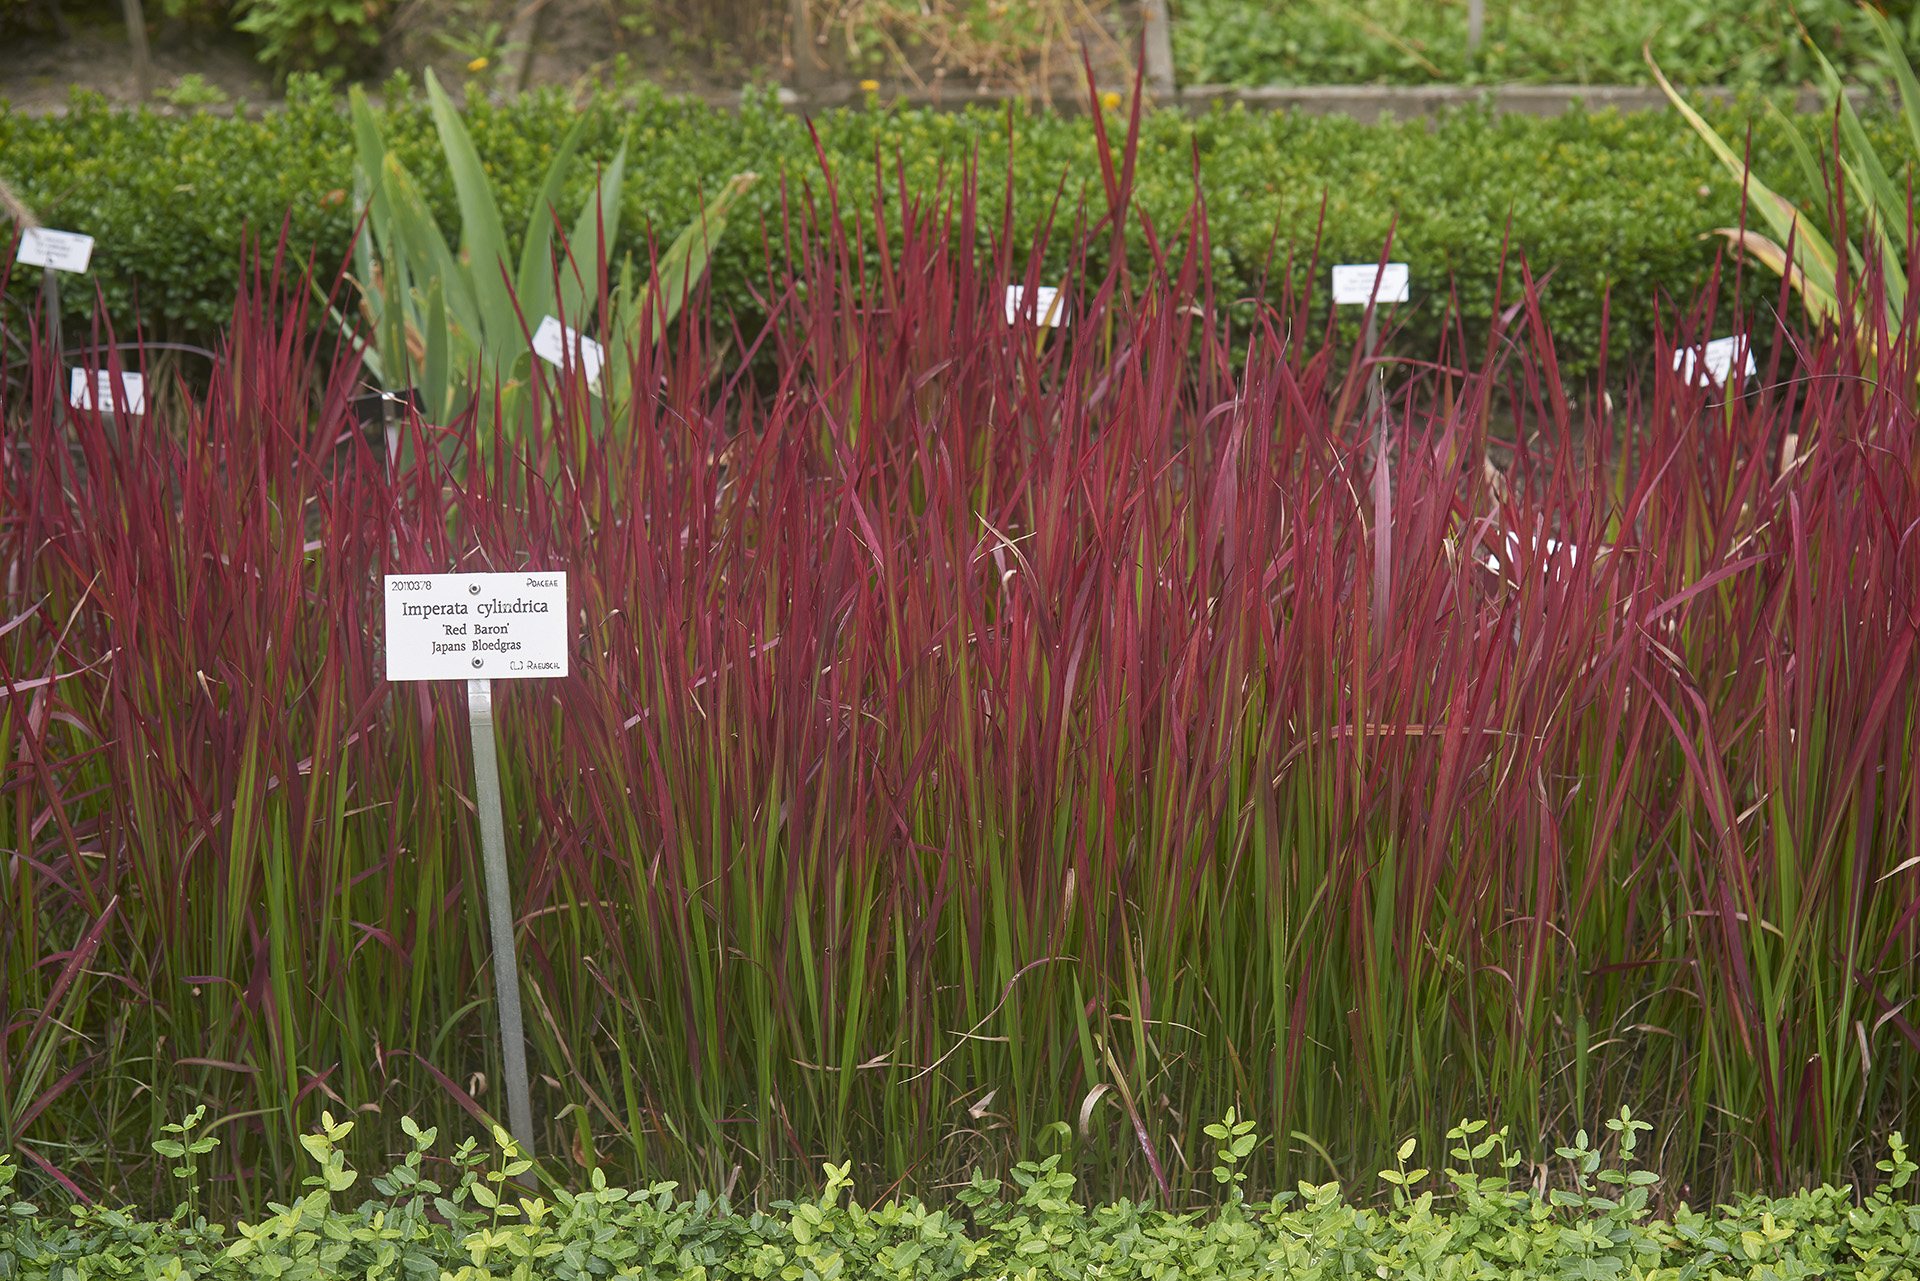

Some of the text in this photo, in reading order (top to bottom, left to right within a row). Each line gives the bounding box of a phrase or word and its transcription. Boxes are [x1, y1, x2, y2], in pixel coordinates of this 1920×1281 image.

[392, 580, 432, 591] 20110378
[402, 598, 548, 619] Imperata cylindrica
[432, 639, 521, 655] Japans Bloedgras
